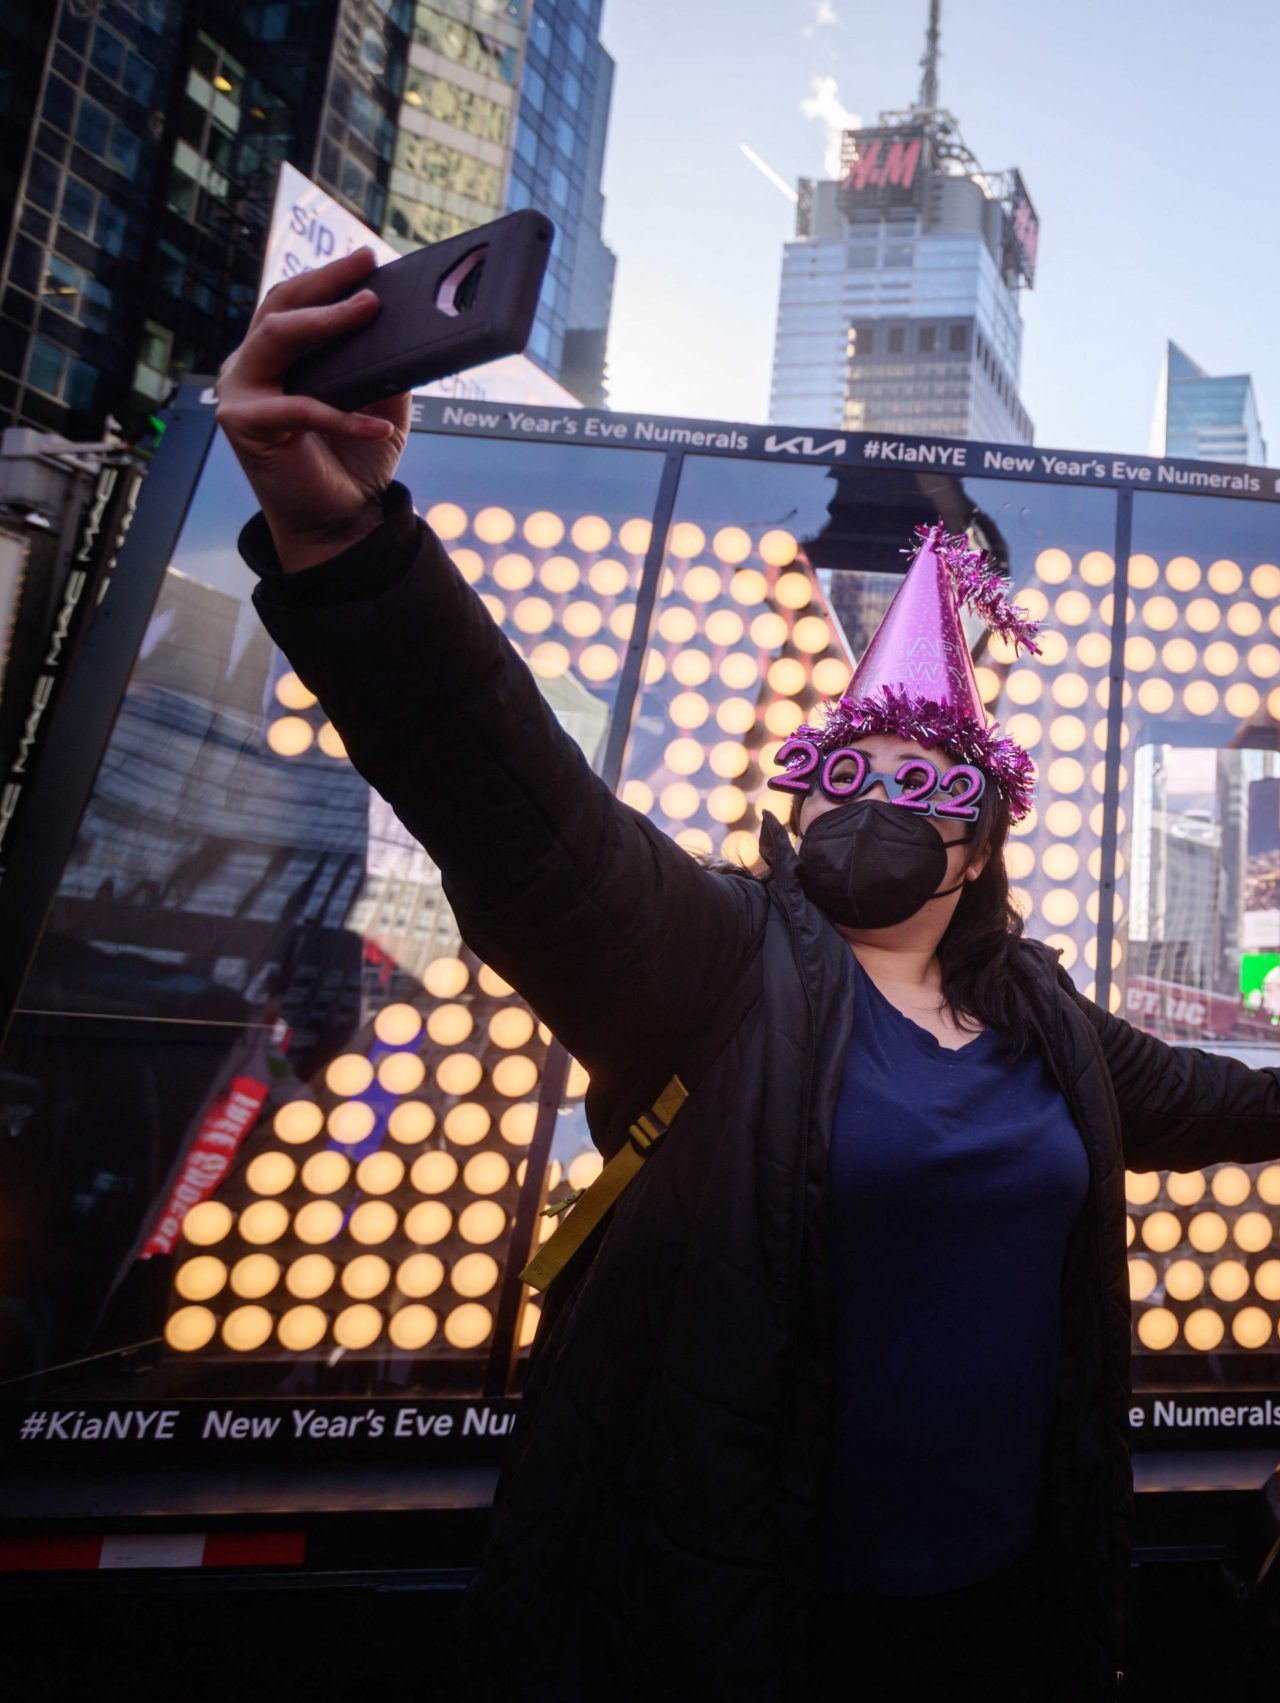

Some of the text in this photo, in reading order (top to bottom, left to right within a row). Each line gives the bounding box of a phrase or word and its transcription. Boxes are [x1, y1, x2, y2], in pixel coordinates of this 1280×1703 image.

[842, 138, 923, 191] H&M
[289, 204, 336, 258] sip
[442, 406, 500, 428] New
[507, 411, 577, 435] Year's
[584, 417, 628, 439] Eve
[635, 422, 749, 450] Numerals
[864, 439, 967, 467] #KiaNYE
[984, 450, 1035, 472] New
[1041, 456, 1106, 478] Year's
[1112, 461, 1151, 482] Eve
[1157, 465, 1260, 492] Numerals
[767, 739, 985, 821] 2022
[20, 1407, 517, 1440] #KiaNYE New Year's Eve Nu
